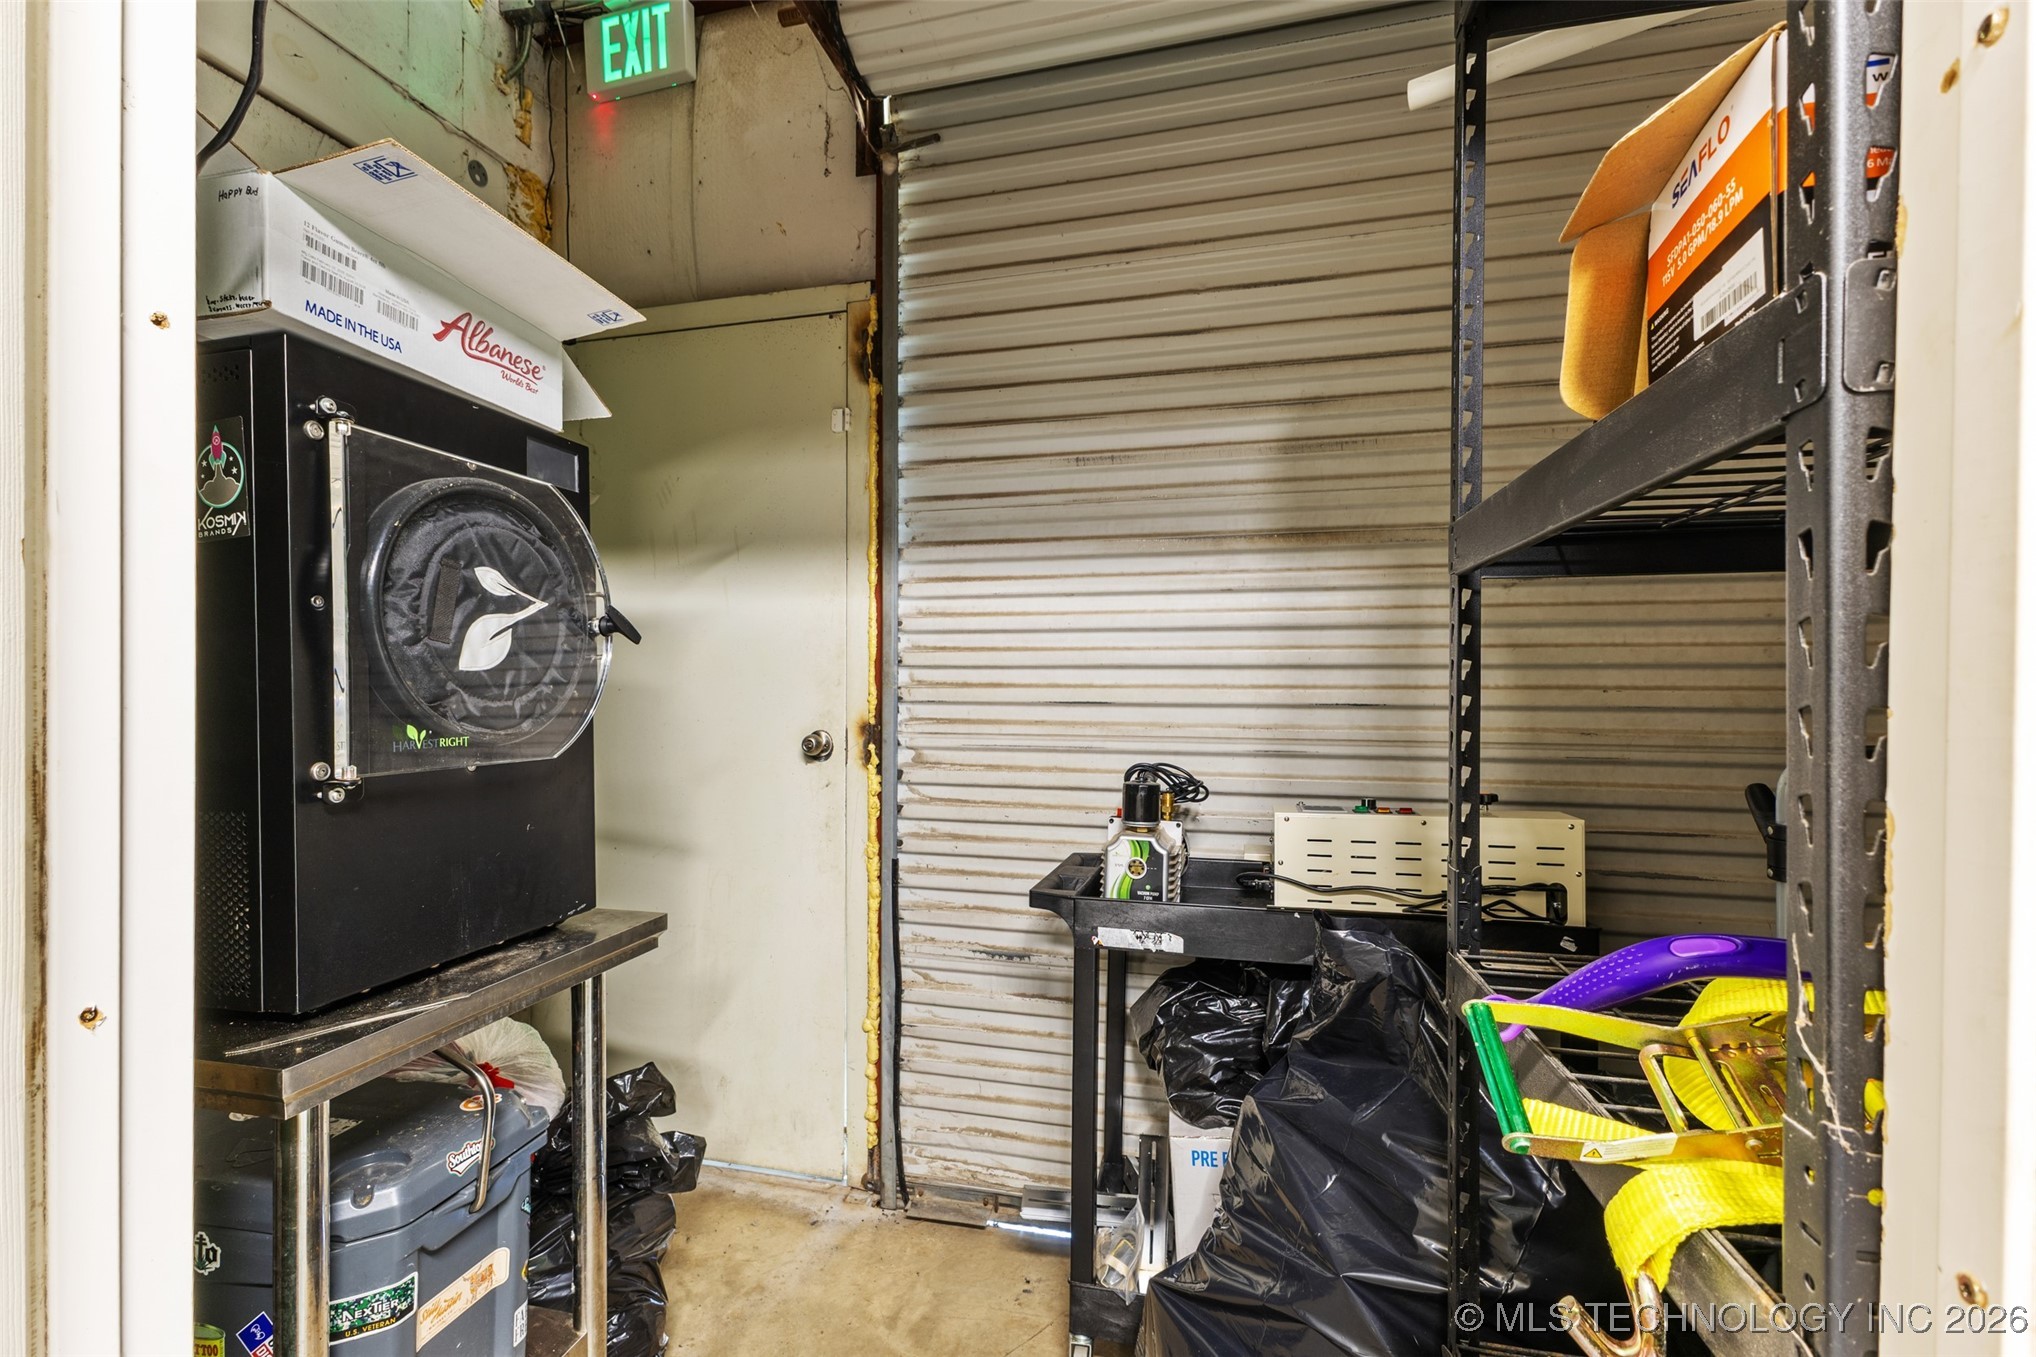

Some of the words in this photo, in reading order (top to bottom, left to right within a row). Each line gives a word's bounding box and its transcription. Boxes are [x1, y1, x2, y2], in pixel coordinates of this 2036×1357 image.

[602, 2, 671, 83] EXIT
[1672, 115, 1730, 209] SEAFLO
[311, 224, 329, 238] Flavor
[1677, 250, 1688, 270] 5.0
[1724, 186, 1744, 217] LPM
[305, 299, 342, 327] MADE
[344, 317, 356, 333] IN
[357, 322, 379, 344] THE
[380, 333, 402, 354] USA
[432, 312, 543, 382] Albanese
[197, 507, 247, 536] KOSMIK
[198, 527, 232, 538] BRANDS
[1191, 1150, 1218, 1168] PRE
[345, 1328, 360, 1337] U.S.
[362, 1317, 396, 1332] VETERAN
